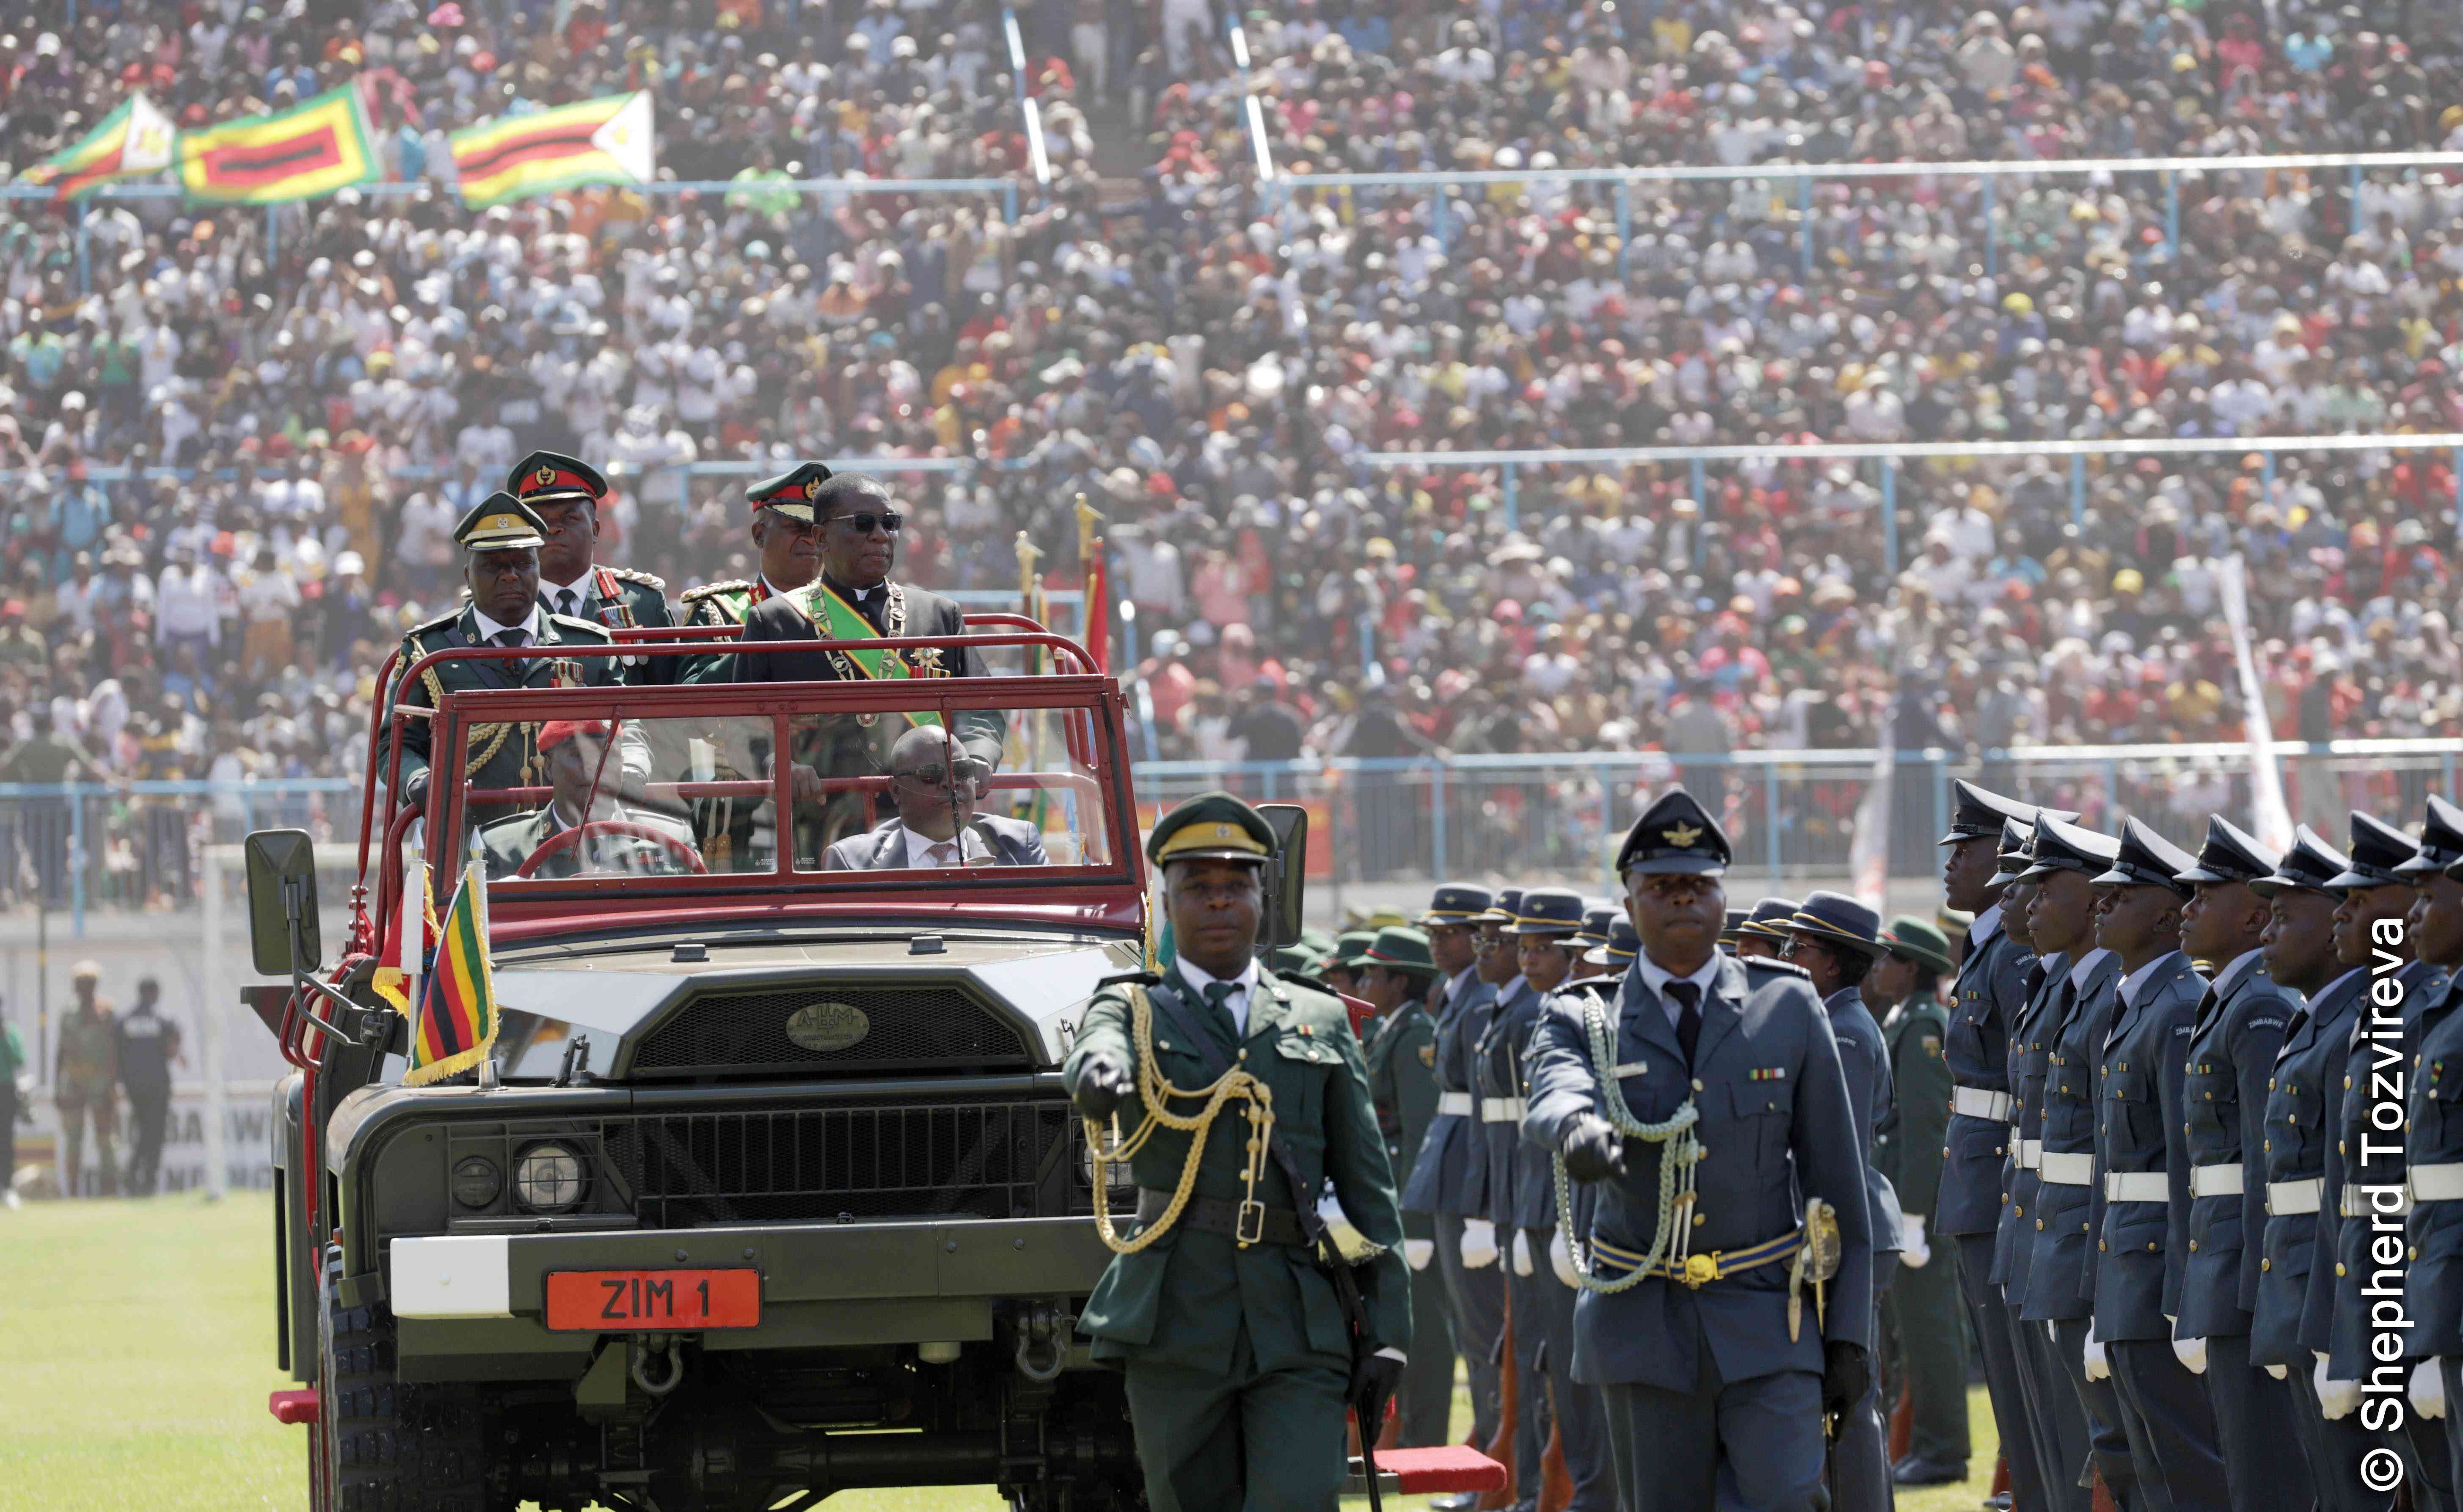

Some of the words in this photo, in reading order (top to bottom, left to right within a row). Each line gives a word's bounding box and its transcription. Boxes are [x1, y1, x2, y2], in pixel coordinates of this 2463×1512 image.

[2015, 953, 2038, 965] ZIMBAB
[2248, 1018, 2283, 1029] ZIMBABWE
[601, 1278, 673, 1319] ZIM
[697, 1279, 709, 1316] 1
